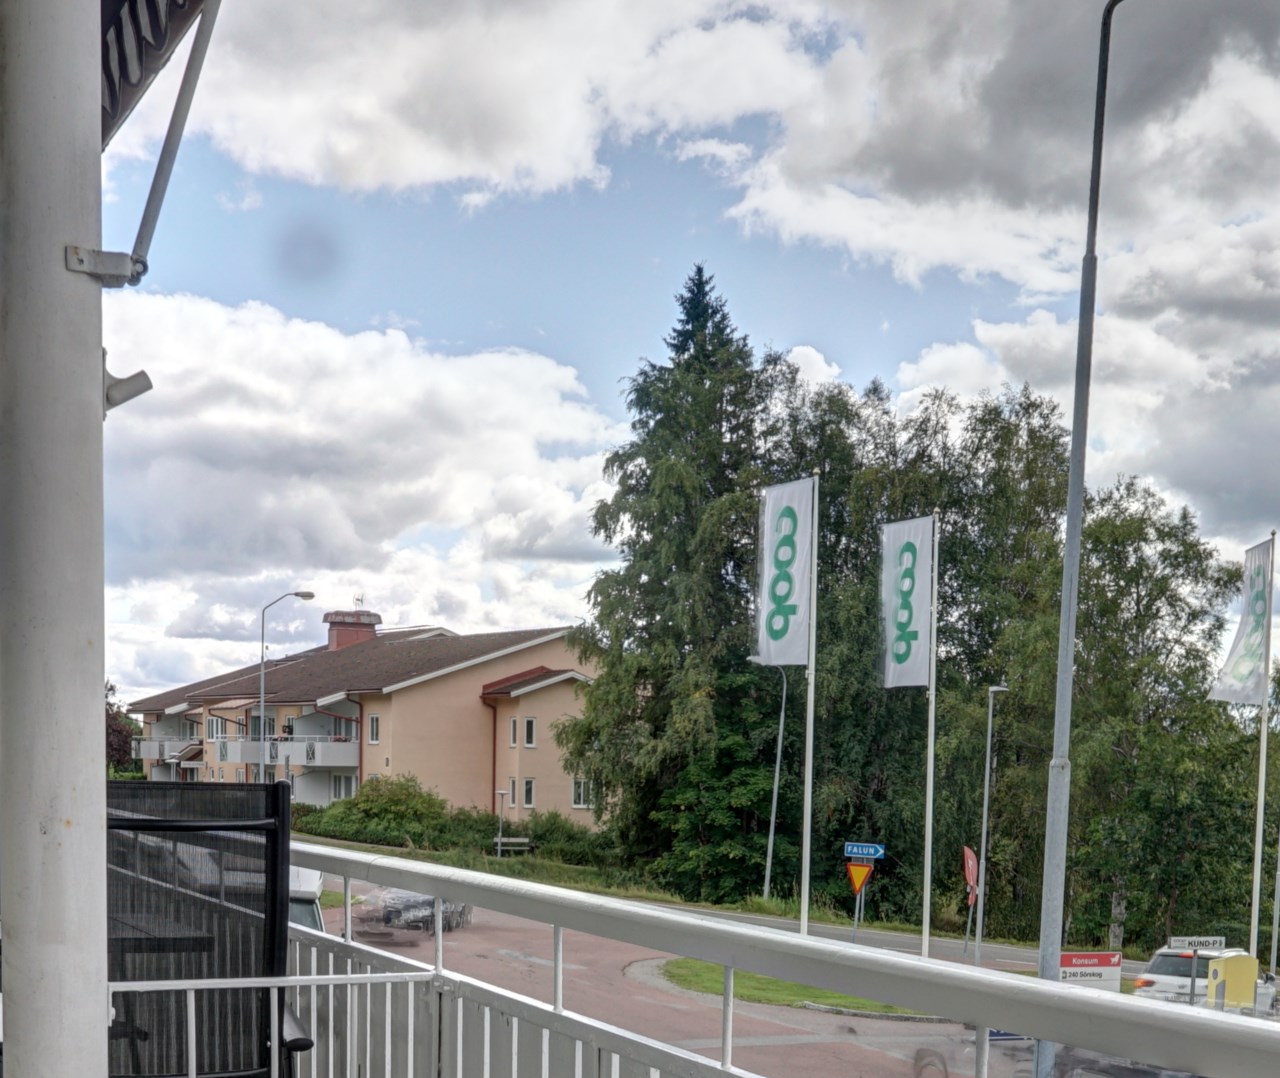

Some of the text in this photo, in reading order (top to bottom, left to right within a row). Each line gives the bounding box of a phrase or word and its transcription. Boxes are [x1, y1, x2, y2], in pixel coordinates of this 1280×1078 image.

[847, 845, 875, 855] FALUN
[1188, 940, 1218, 948] KUND-P
[1072, 957, 1099, 965] Konsum
[1080, 970, 1103, 979] Sörskog
